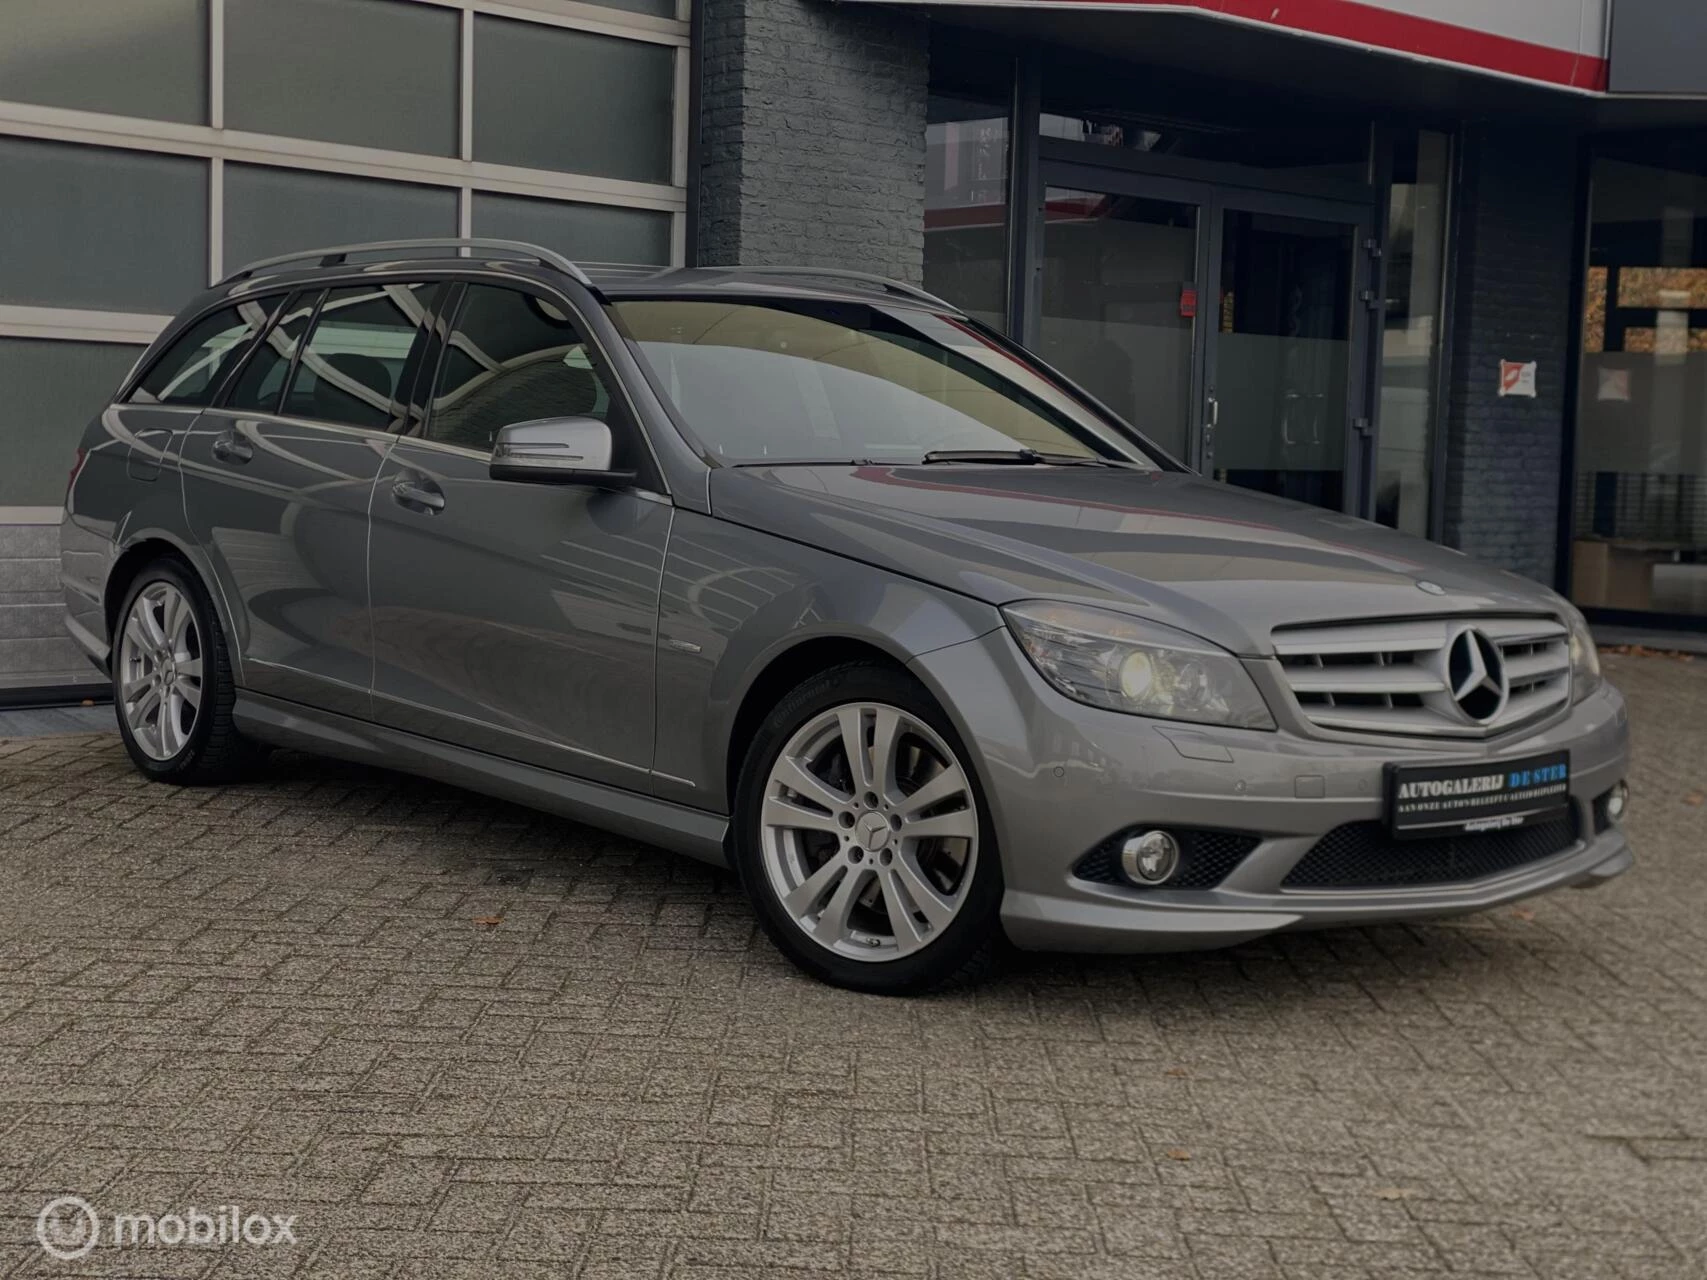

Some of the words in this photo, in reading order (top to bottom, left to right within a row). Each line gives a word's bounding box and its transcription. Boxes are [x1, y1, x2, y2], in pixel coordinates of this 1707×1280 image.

[1398, 774, 1505, 799] AUTOGALERIJ
[1509, 770, 1531, 788] DE
[1533, 763, 1567, 783] STER
